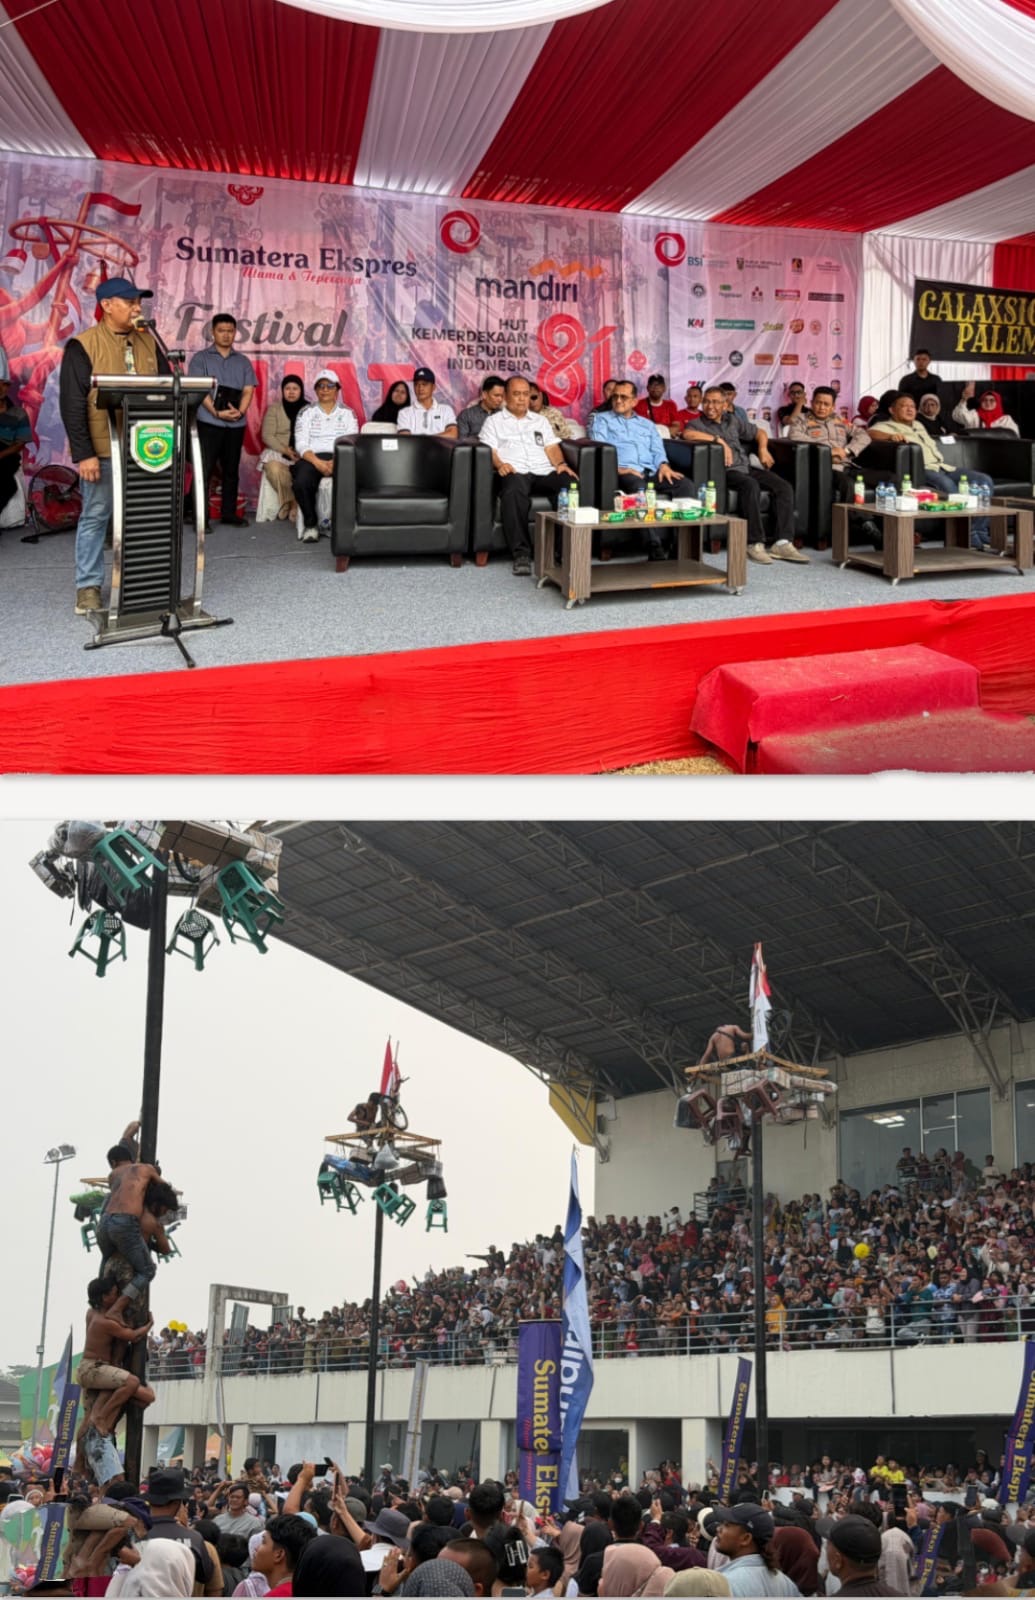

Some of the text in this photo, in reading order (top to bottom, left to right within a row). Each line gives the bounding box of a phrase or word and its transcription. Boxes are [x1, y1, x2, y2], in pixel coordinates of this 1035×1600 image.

[175, 237, 417, 279] Sumatera Ekspres
[475, 275, 578, 302] mandiri
[411, 327, 528, 344] KEMERDEKAAN
[499, 318, 528, 331] HUT
[456, 344, 529, 358] REPUBLIK
[447, 358, 532, 372] INDONESIA
[533, 1359, 557, 1456] Sumate
[729, 1382, 748, 1453] Sumatera
